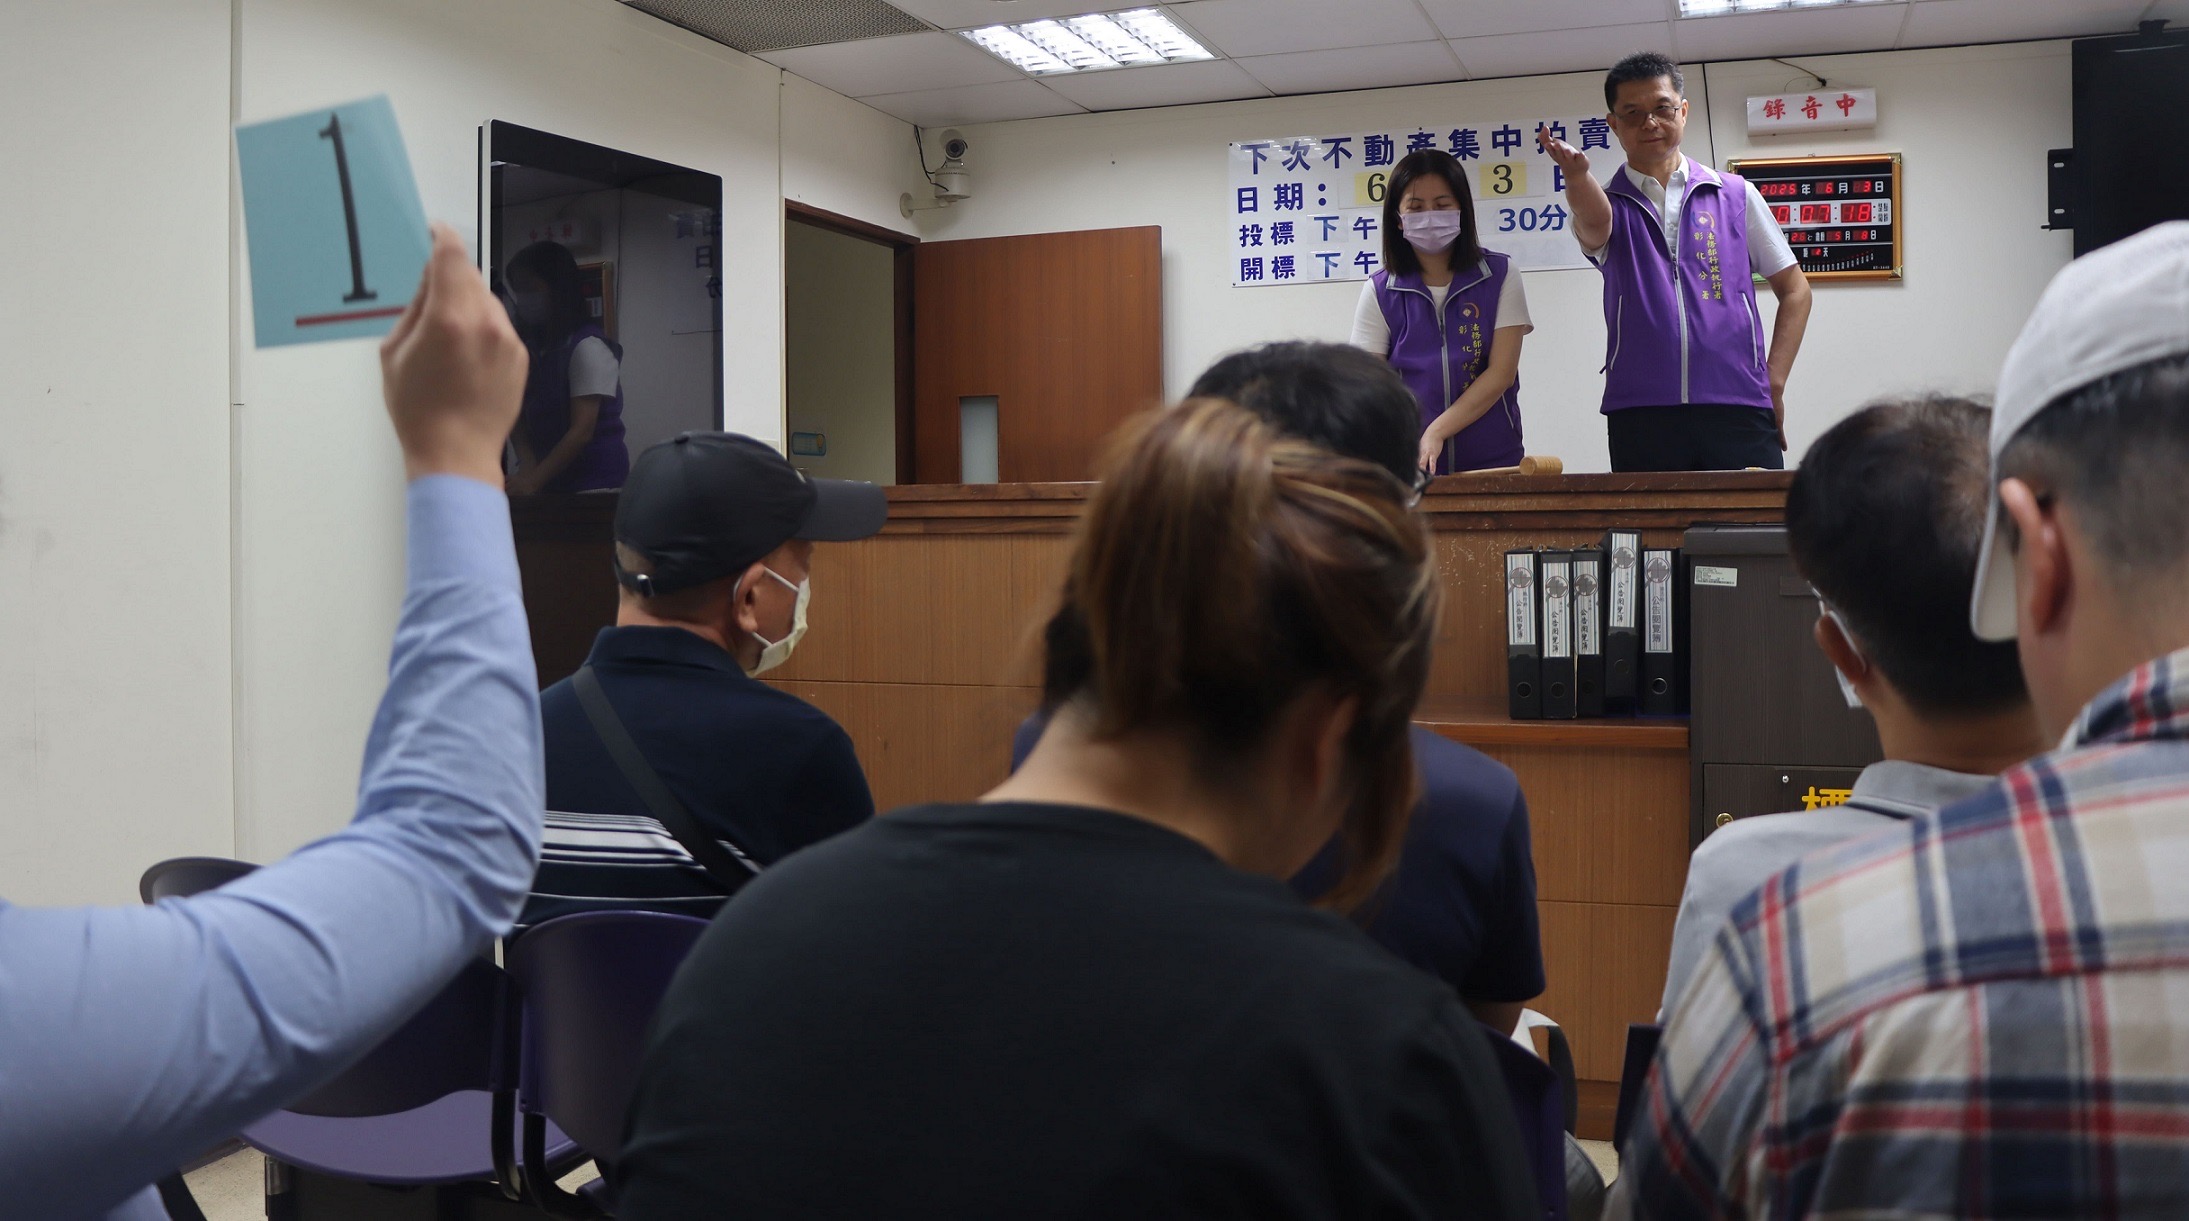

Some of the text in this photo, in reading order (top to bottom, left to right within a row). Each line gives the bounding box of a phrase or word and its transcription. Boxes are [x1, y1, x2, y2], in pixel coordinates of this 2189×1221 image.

[1763, 93, 1856, 120] 錄音中
[1367, 173, 1387, 202] 6
[1493, 164, 1514, 195] 3
[318, 111, 378, 302] 1
[1498, 204, 1568, 232] 30分
